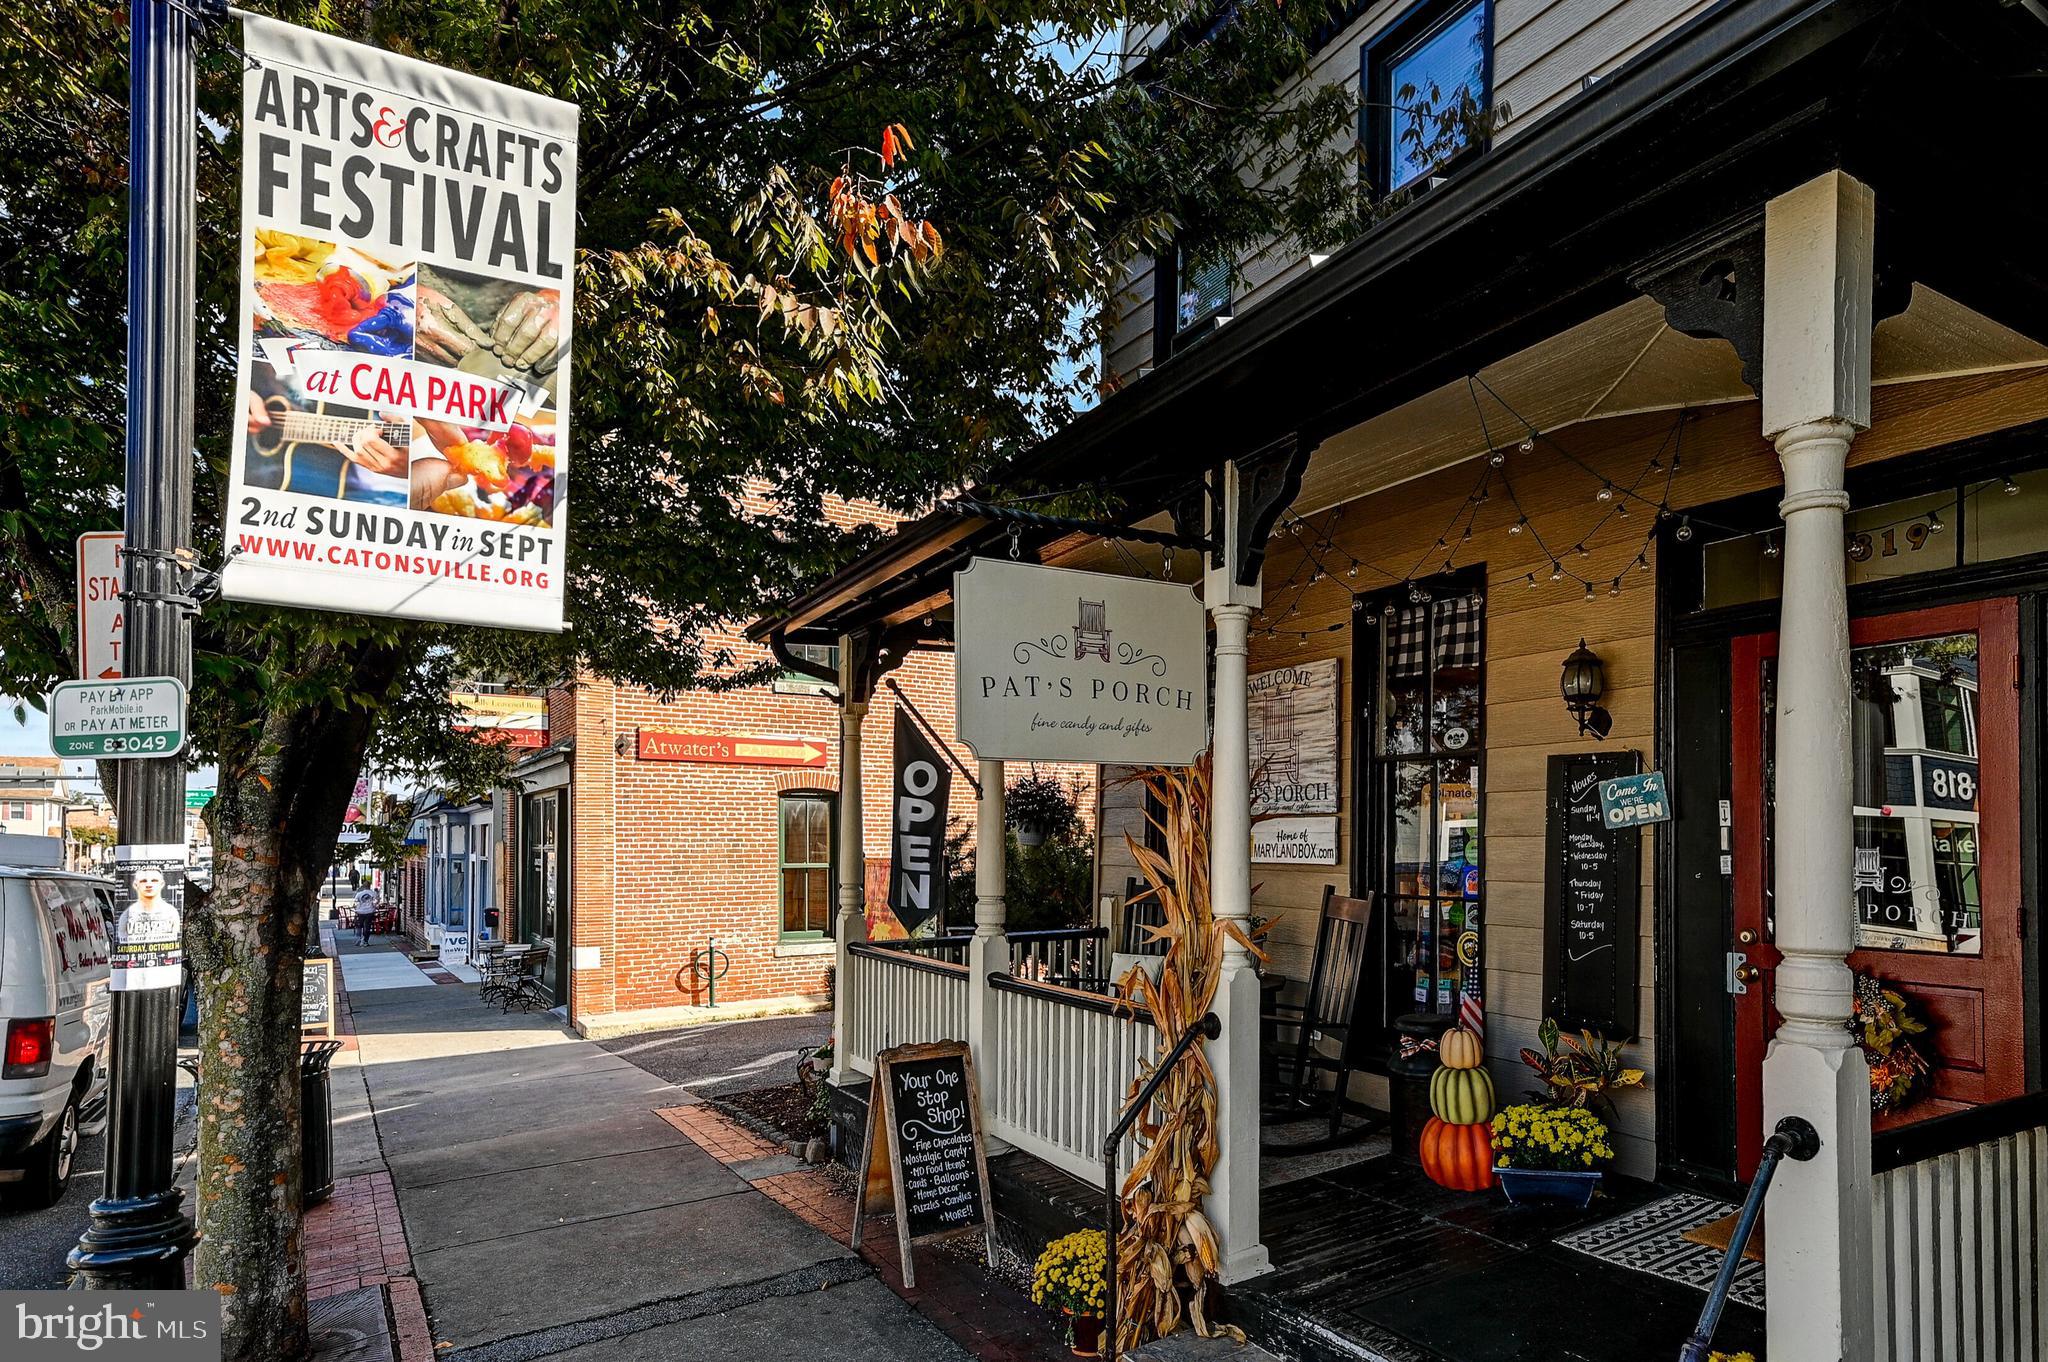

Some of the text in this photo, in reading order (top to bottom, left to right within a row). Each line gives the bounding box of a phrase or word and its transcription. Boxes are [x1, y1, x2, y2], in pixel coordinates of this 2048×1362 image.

[258, 132, 563, 280] FESTIVAL
[306, 363, 509, 425] at CAA PARK
[240, 496, 553, 564] 2nd SUNDAY in SEPT
[1849, 523, 1930, 562] 819
[239, 533, 549, 589] WWW.CATONSVILLE.ORG
[1248, 668, 1313, 696] WELCOME
[80, 688, 154, 703] PAY BY APP
[981, 675, 1193, 711] PAT'S PORCH
[90, 704, 143, 715] ParkMobile.io
[64, 716, 169, 732] OR PAY AT METER
[1030, 712, 1153, 738] fine candy and gifts
[68, 735, 167, 753] ZONE 83049
[643, 737, 730, 758] Atwater's
[1274, 782, 1329, 803] PORCH
[1606, 777, 1659, 801] Come In
[1570, 804, 1597, 814] Sunday
[1619, 795, 1645, 806] WE'RE
[1586, 813, 1600, 822] 11-4
[1608, 801, 1663, 823] OPEN
[899, 760, 938, 910] OPEN
[1276, 828, 1309, 843] Home of
[1932, 833, 1975, 854] take
[1254, 843, 1334, 860] MARYLANDBOX.com
[1573, 851, 1608, 861] Wednesday
[1581, 862, 1598, 871] 10-5
[1569, 878, 1602, 889] Thursday
[1580, 890, 1604, 901] Friday
[1576, 903, 1594, 914] 10-7
[1866, 904, 1969, 928] PORCH
[1570, 920, 1605, 931] Saturday
[900, 1069, 959, 1091] Your One
[916, 1090, 949, 1109] Stop
[927, 1100, 966, 1128] Shop!
[915, 1132, 973, 1152] Fine Chocolates
[905, 1145, 967, 1165] Nostalgic Candy
[912, 1159, 966, 1177] MD Food Items
[908, 1169, 970, 1190] Cards Balloons
[916, 1183, 961, 1200] Home Decor
[913, 1192, 972, 1214] Puzzles Candles
